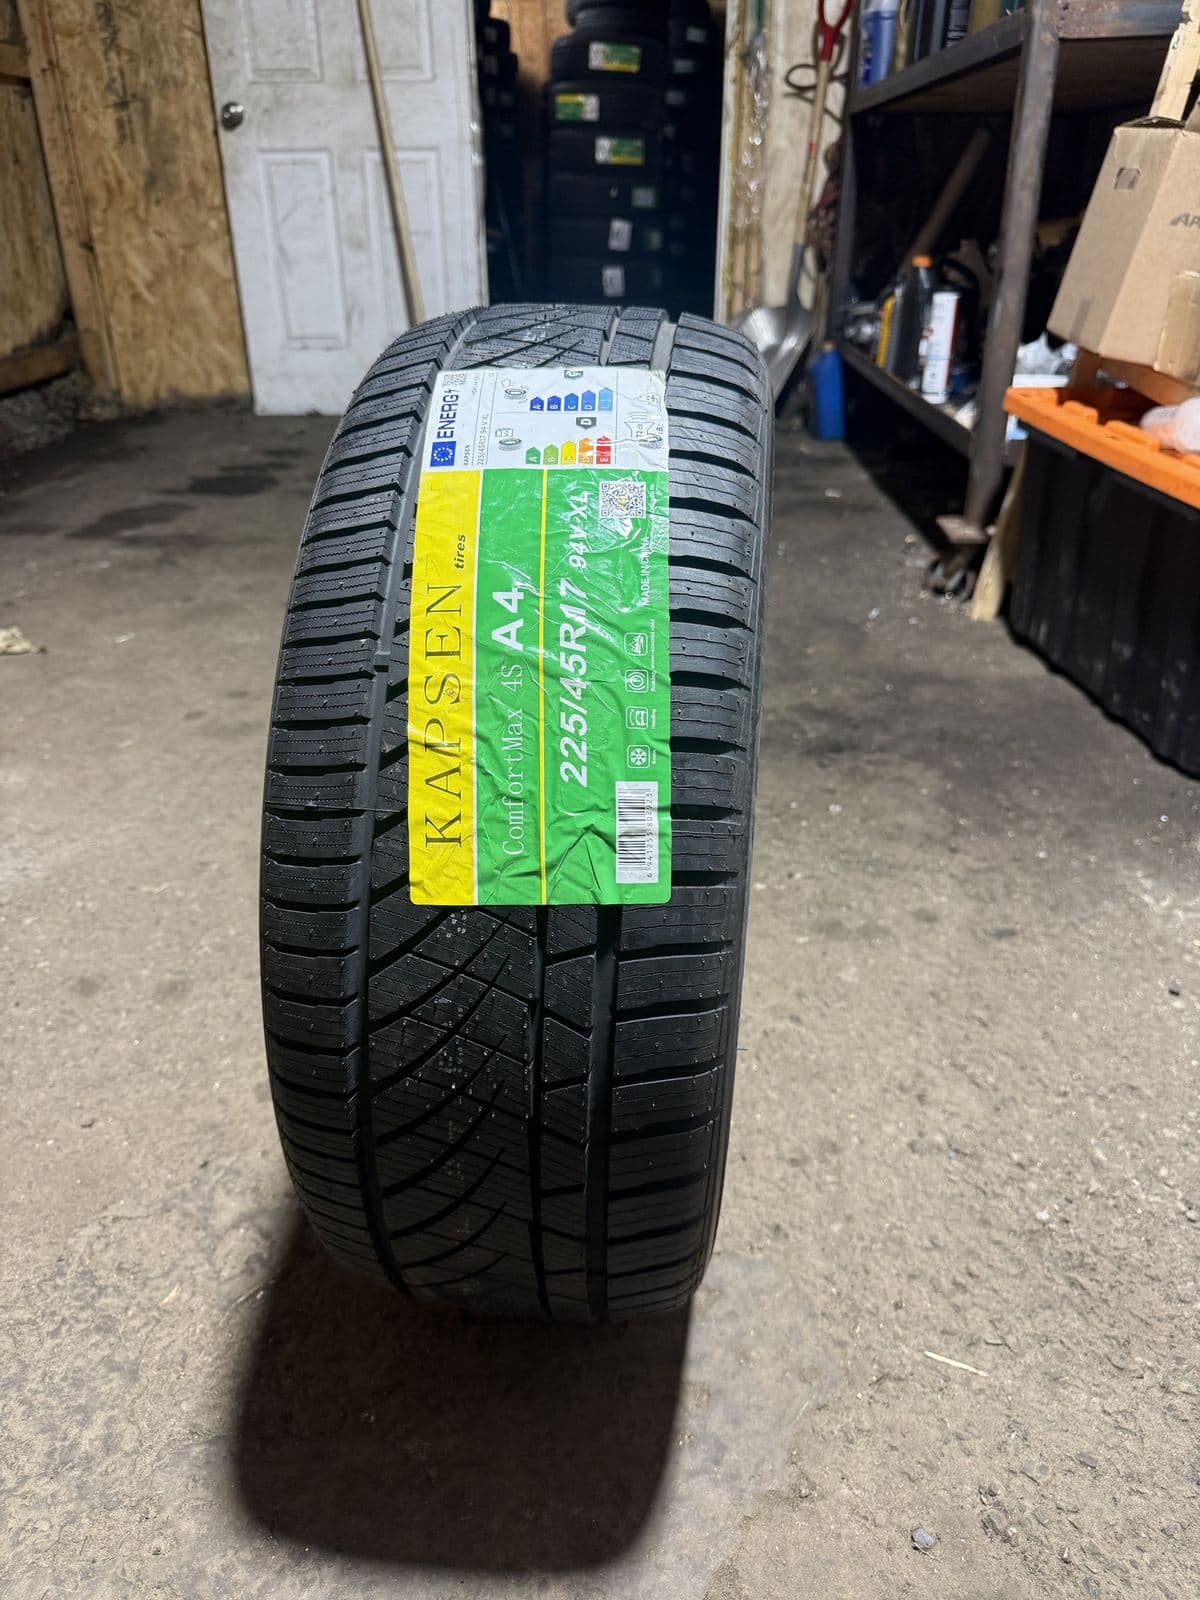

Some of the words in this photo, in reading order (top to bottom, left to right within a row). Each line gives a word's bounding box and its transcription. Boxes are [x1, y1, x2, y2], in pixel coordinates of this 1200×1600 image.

[580, 418, 592, 426] D
[454, 534, 466, 570] tires
[640, 565, 650, 576] IN
[640, 578, 650, 606] MADE
[491, 590, 525, 650] A4
[502, 663, 523, 693] 4S
[560, 577, 588, 788] 225/45R17
[424, 583, 462, 848] KAPSEN
[502, 708, 525, 856] ComfortMax
